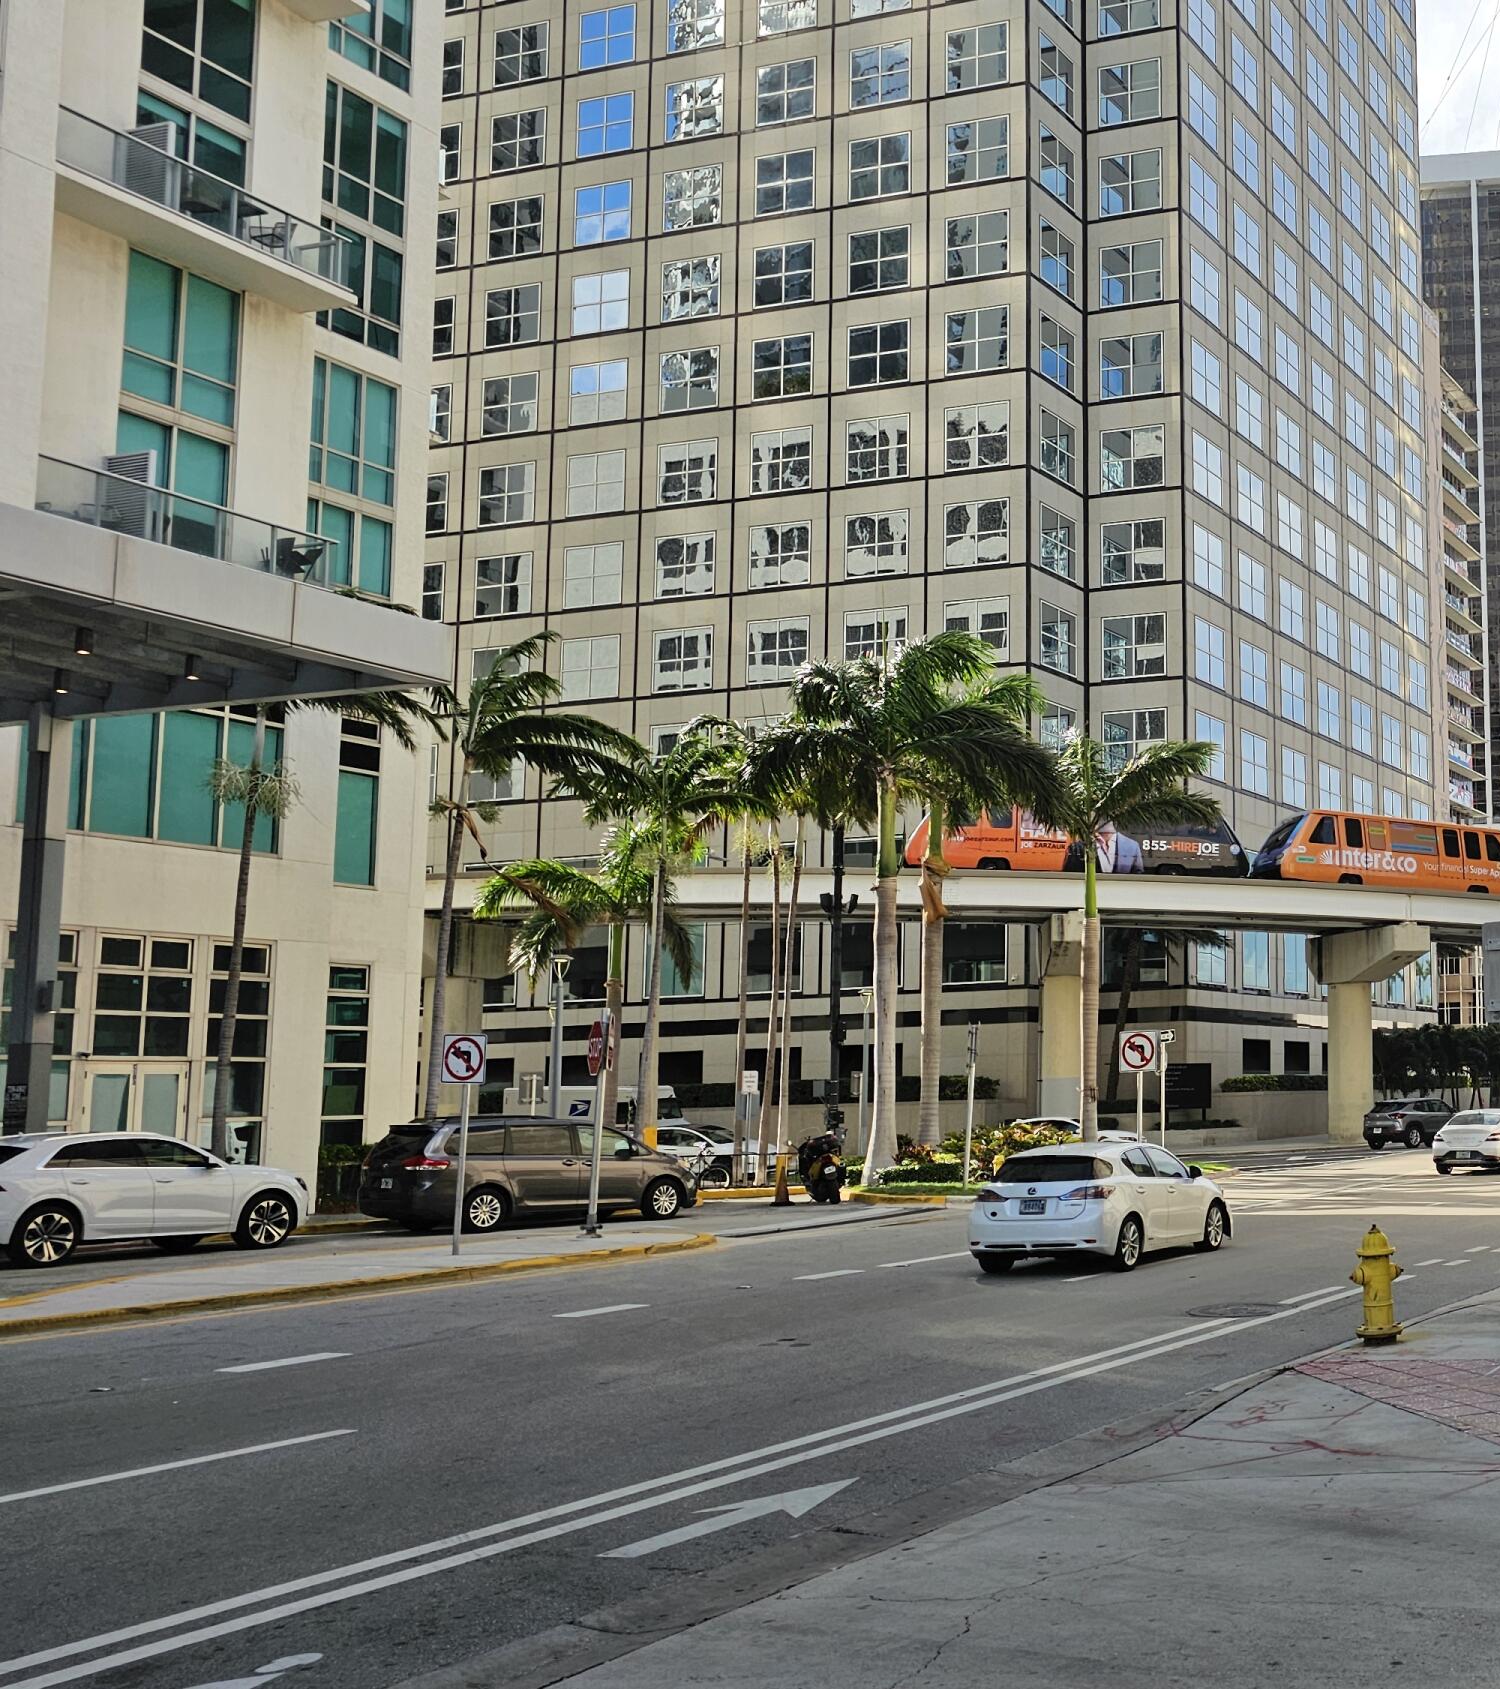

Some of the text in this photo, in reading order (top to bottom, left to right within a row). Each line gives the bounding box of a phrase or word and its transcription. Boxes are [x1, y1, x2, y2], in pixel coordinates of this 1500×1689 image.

[1033, 841, 1066, 850] ZARZAUR
[1423, 861, 1440, 872] Your
[1470, 865, 1488, 876] Super
[589, 1037, 603, 1058] STOP
